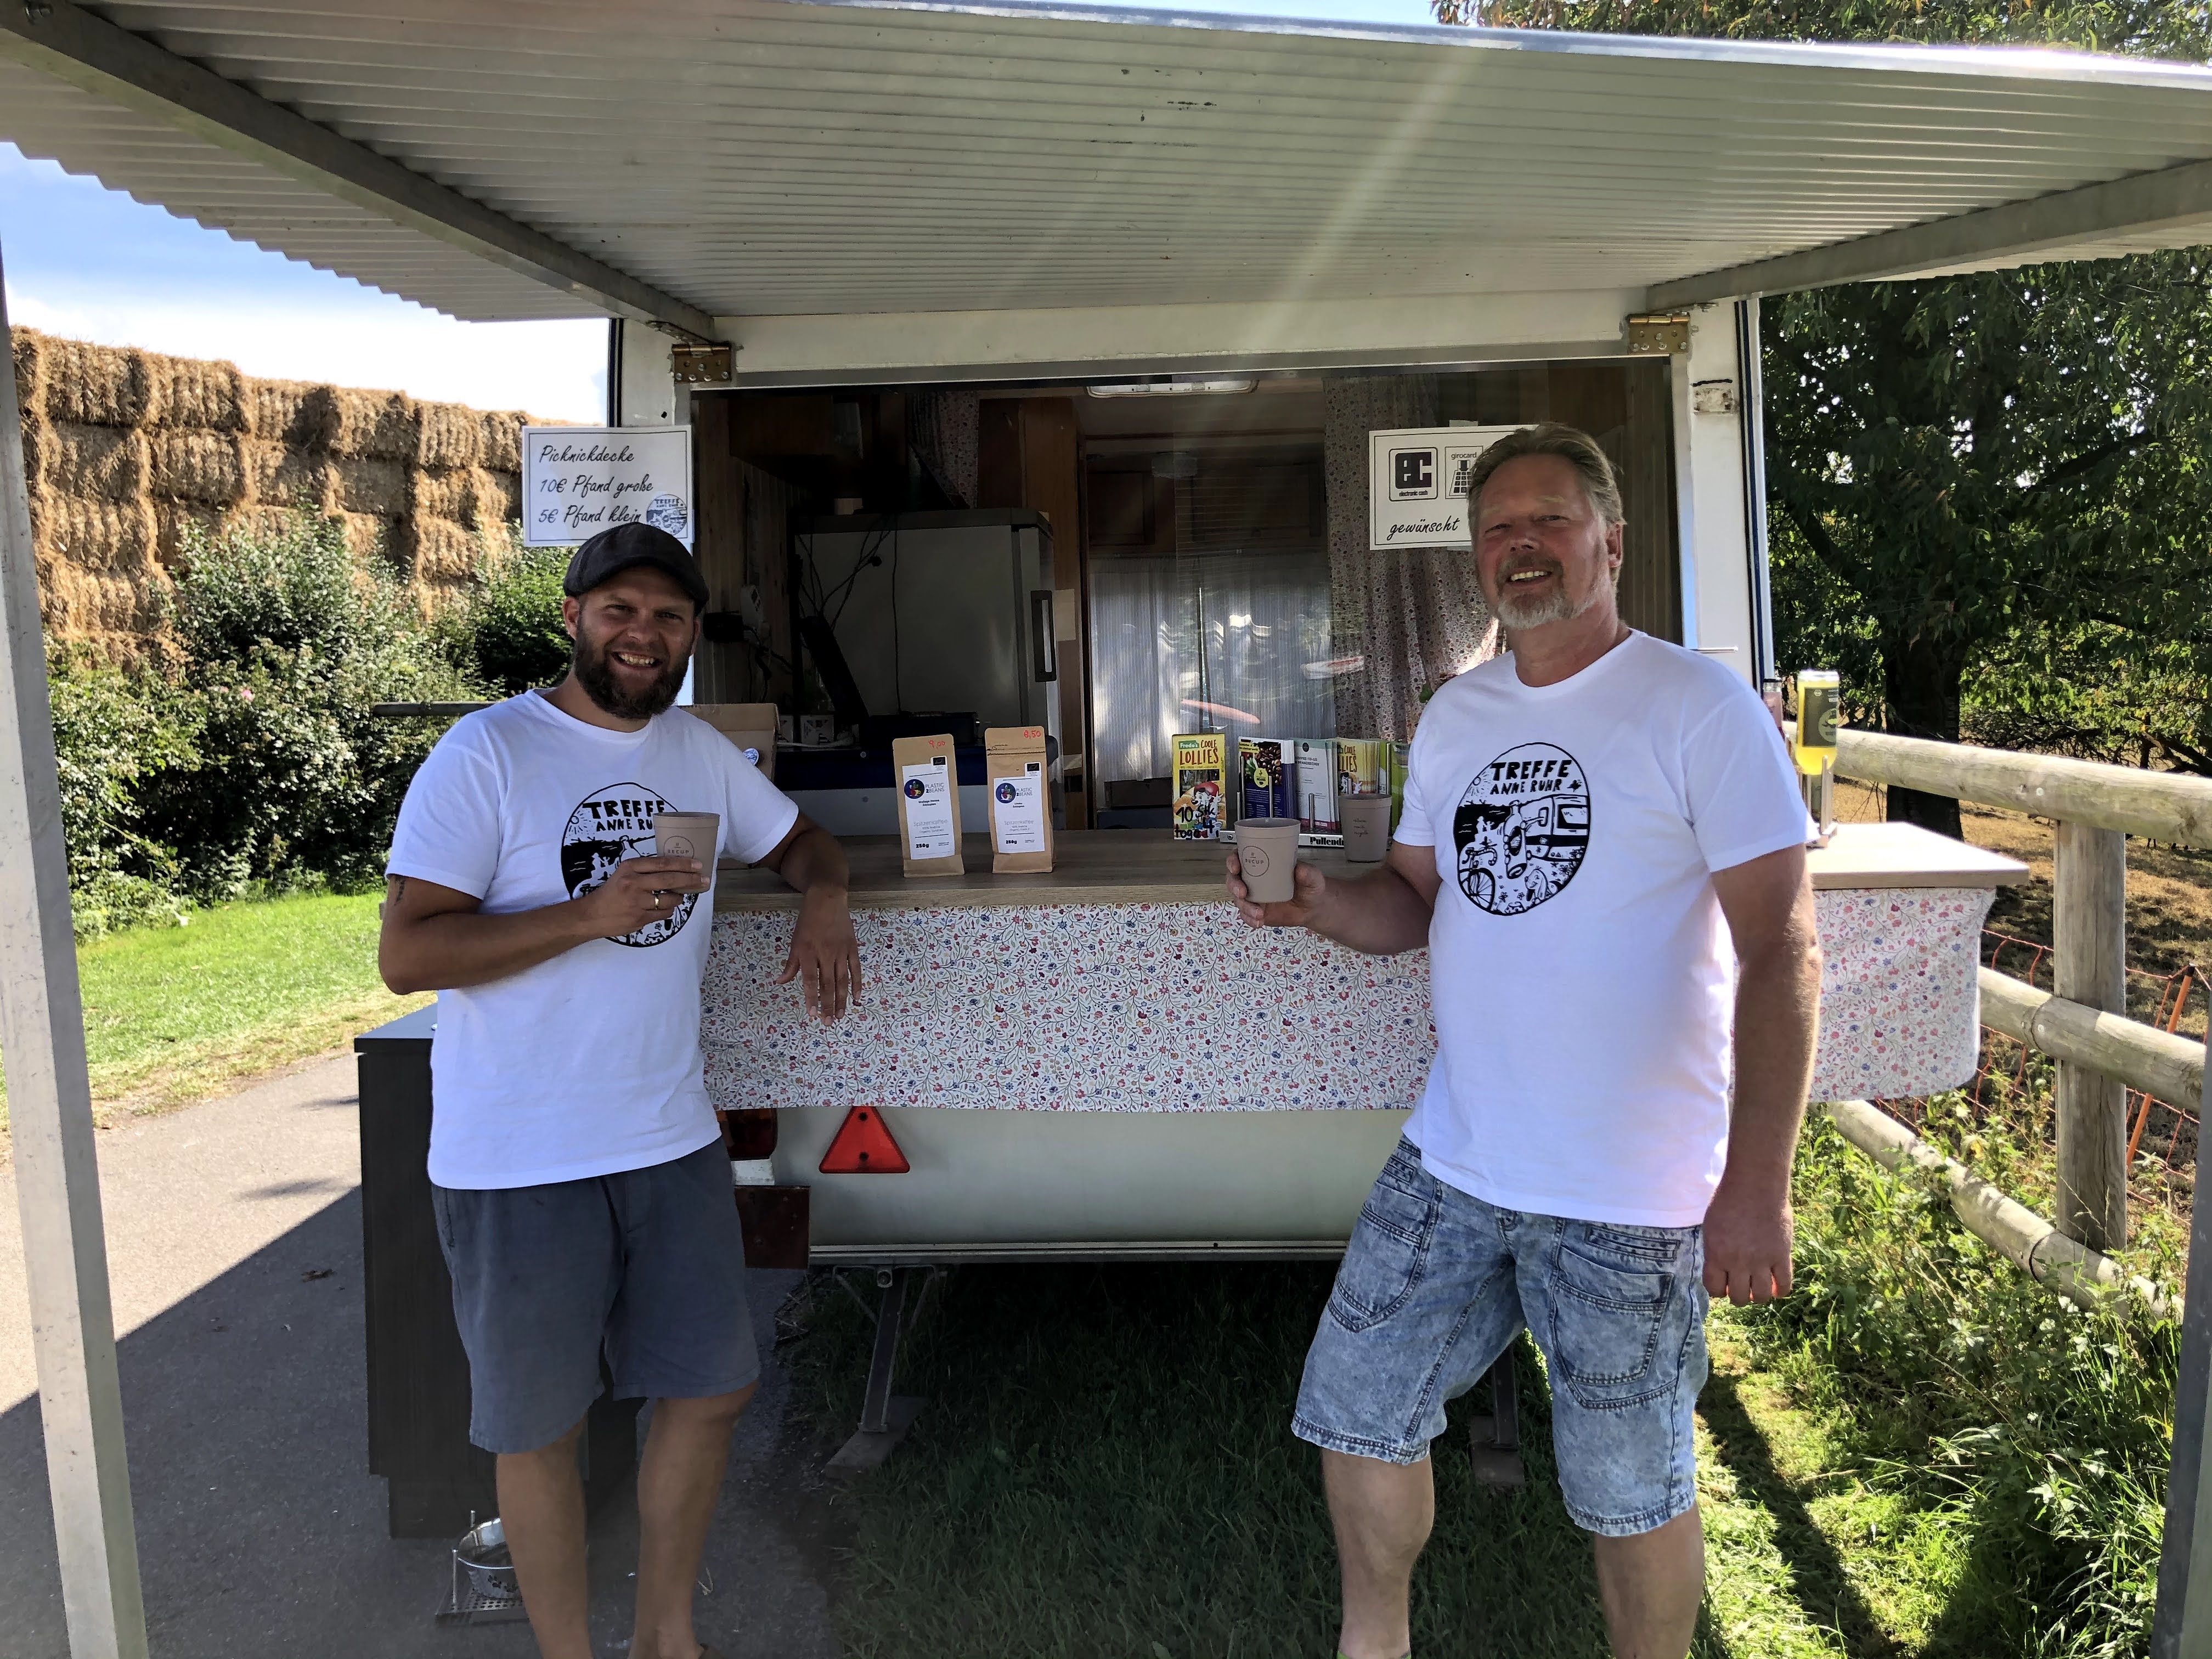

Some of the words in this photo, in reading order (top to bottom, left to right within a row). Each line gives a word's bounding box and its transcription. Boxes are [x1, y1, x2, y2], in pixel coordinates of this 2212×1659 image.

[539, 445, 634, 462] Picknickdecke
[540, 478, 567, 493] 10€
[572, 475, 611, 498] Pfand
[613, 474, 653, 498] große
[539, 509, 558, 523] 5€
[563, 505, 602, 528] Pfand
[608, 505, 641, 522] klein
[1387, 516, 1460, 540] gewünscht
[1200, 740, 1217, 748] COOLE
[1180, 748, 1218, 765] LOLLIES
[1489, 760, 1572, 781] TREFFE
[1530, 779, 1562, 792] RUHR
[1176, 806, 1193, 823] 10
[637, 819, 653, 830] RU
